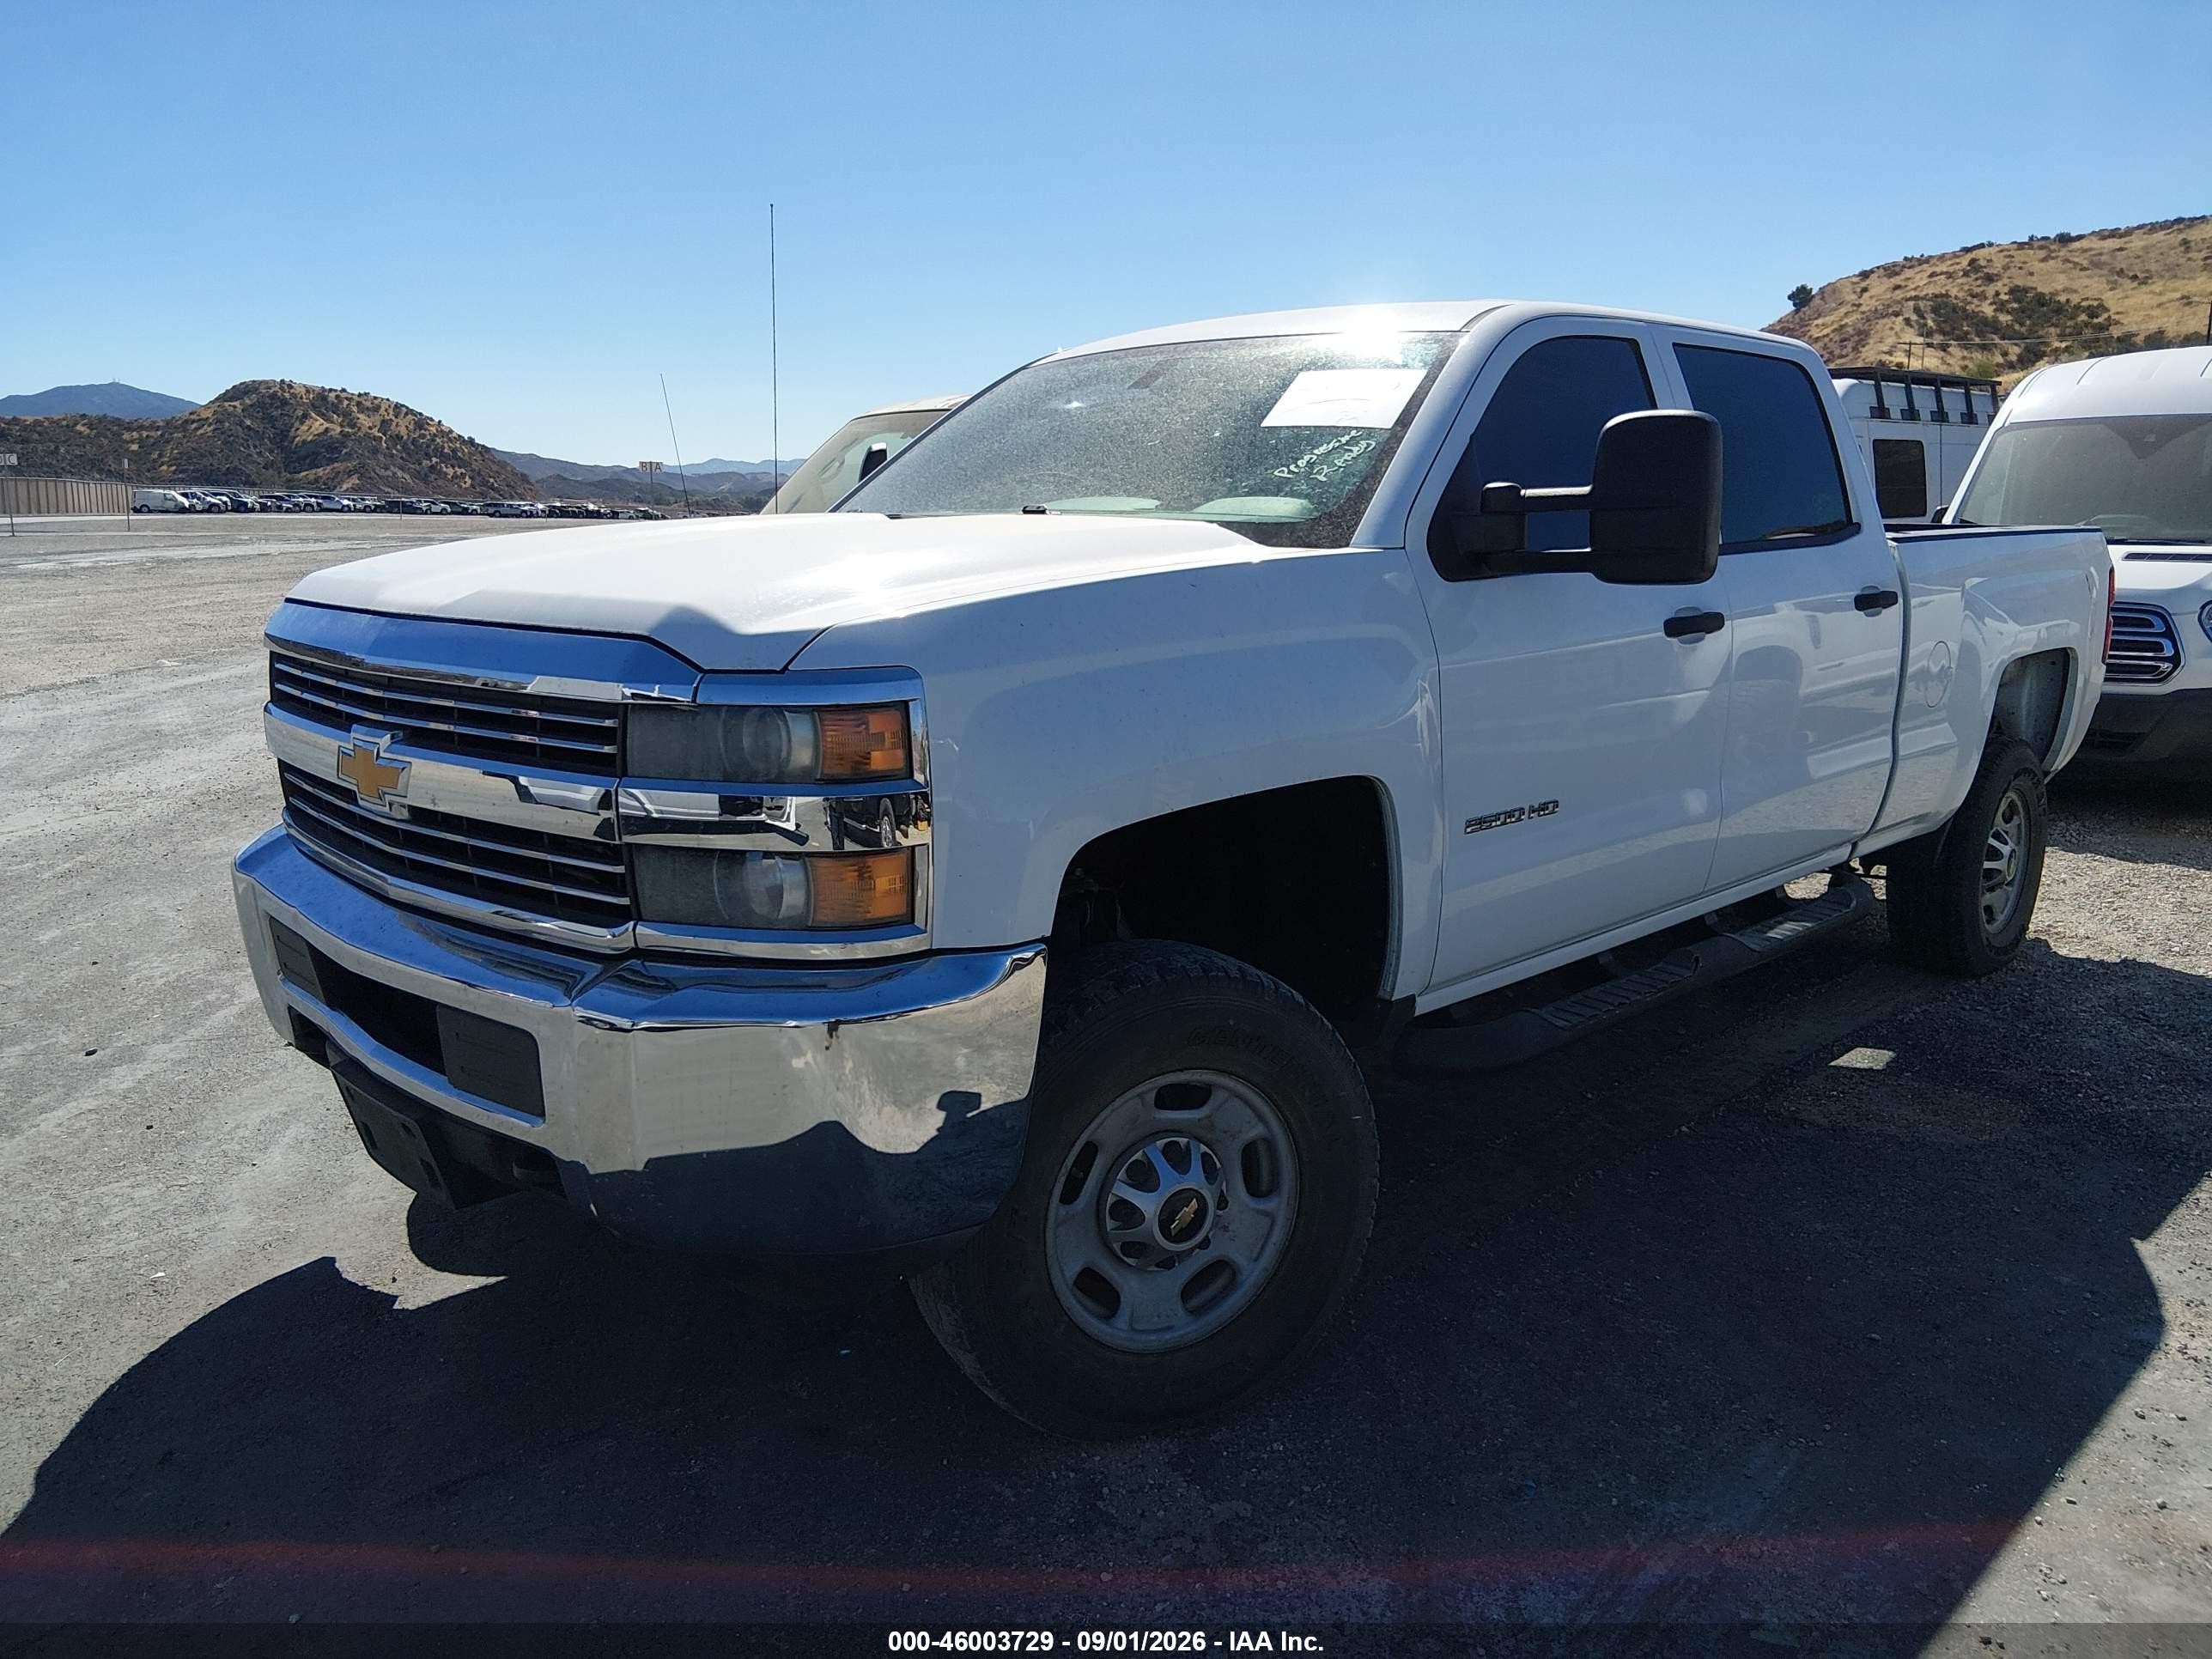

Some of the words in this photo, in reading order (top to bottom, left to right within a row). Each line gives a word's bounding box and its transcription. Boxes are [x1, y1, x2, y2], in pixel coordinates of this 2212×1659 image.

[8, 454, 15, 464] C
[641, 462, 647, 471] B
[654, 462, 662, 472] A
[1464, 806, 1525, 835] 2500
[1528, 799, 1559, 820] HD
